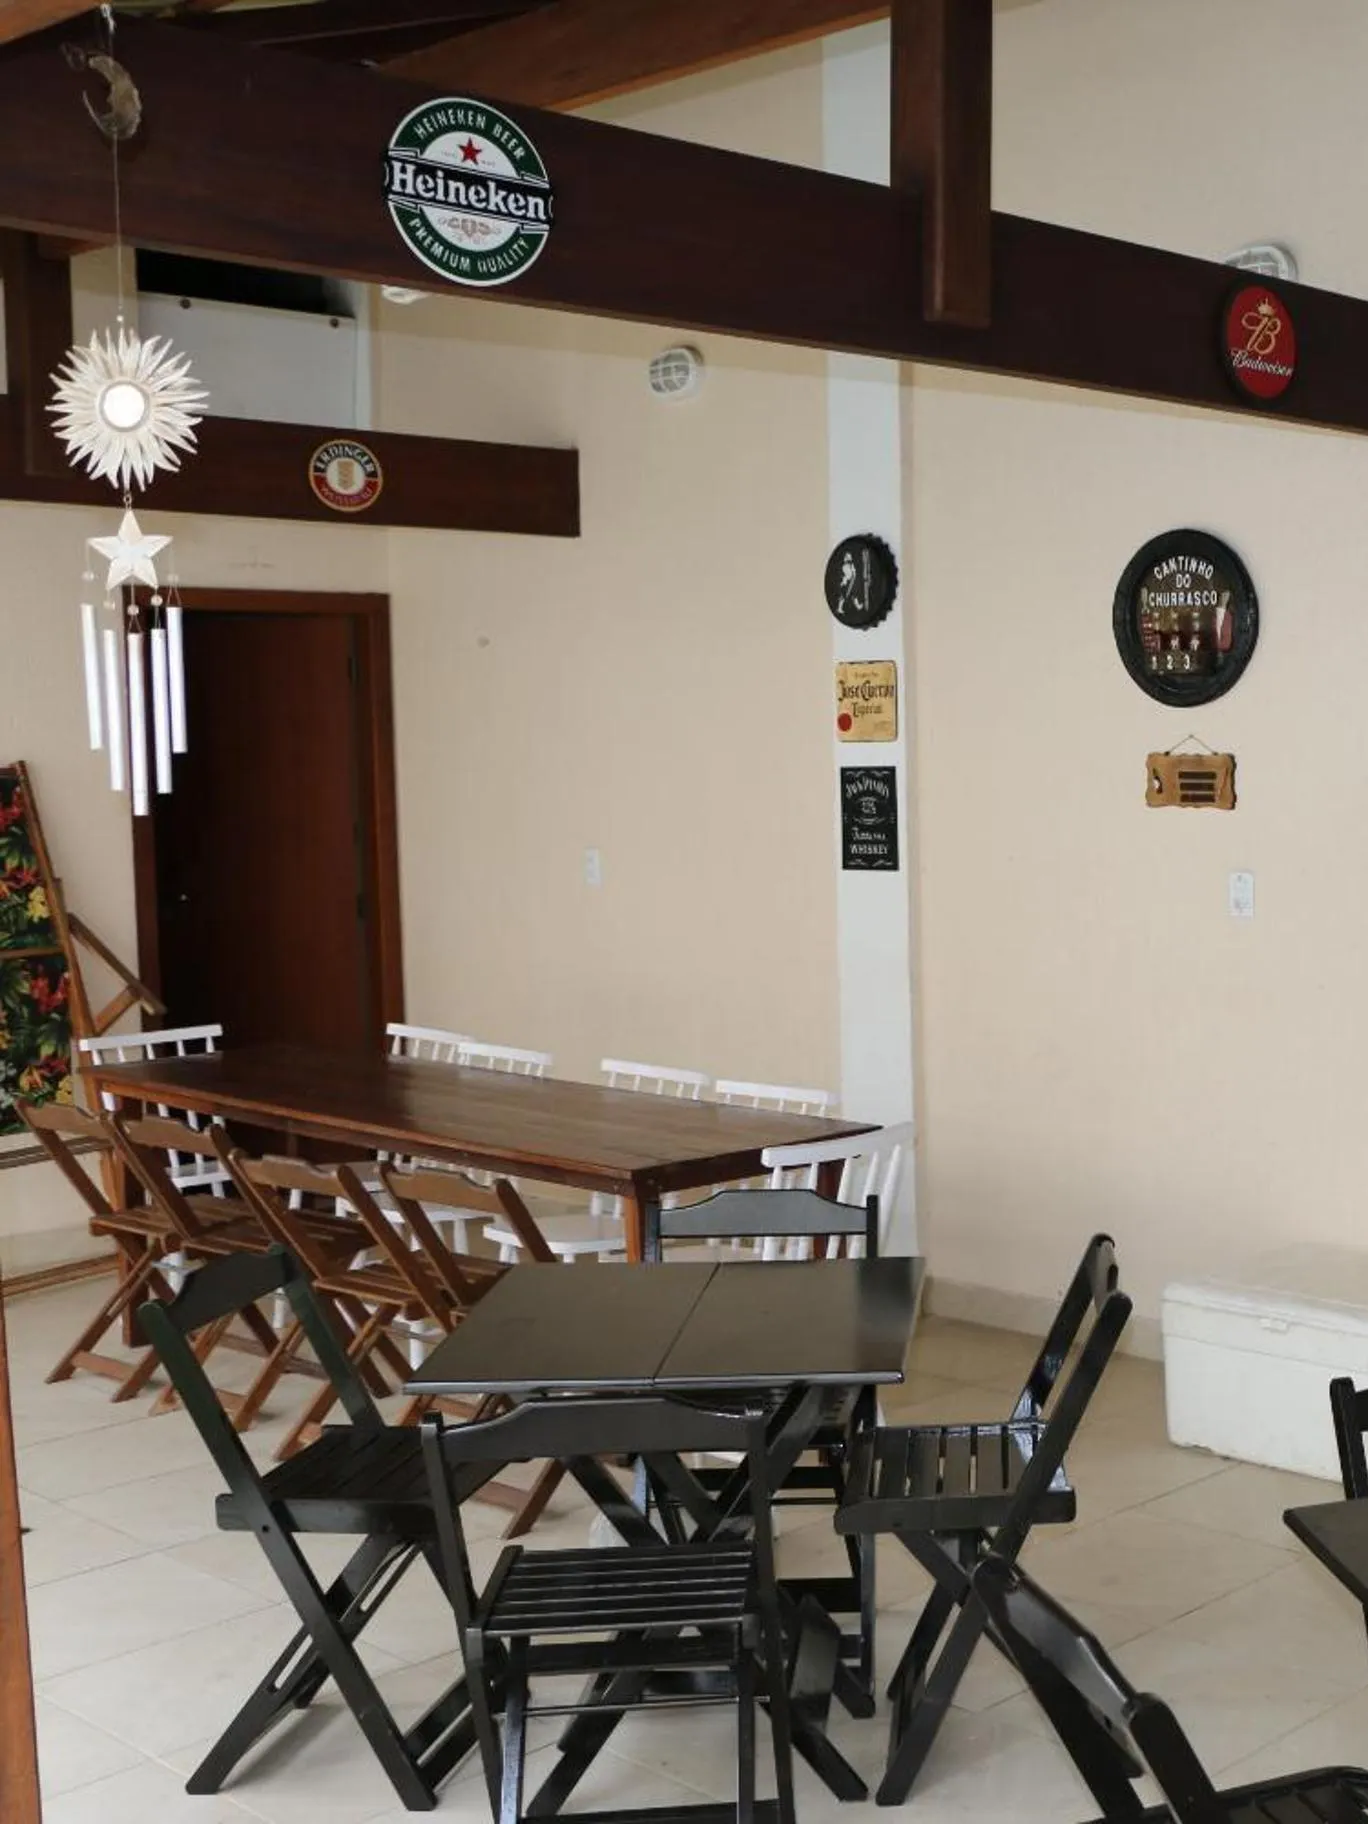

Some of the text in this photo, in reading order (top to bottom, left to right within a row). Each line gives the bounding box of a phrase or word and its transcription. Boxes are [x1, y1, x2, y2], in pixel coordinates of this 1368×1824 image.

[413, 108, 526, 161] HEINEKEN BEER
[391, 160, 547, 220] Heineken
[408, 217, 530, 274] PREMIUM QUALITY
[1153, 555, 1214, 581] CANTINHO
[1175, 572, 1192, 589] DO
[1148, 589, 1218, 608] CHURRASCO
